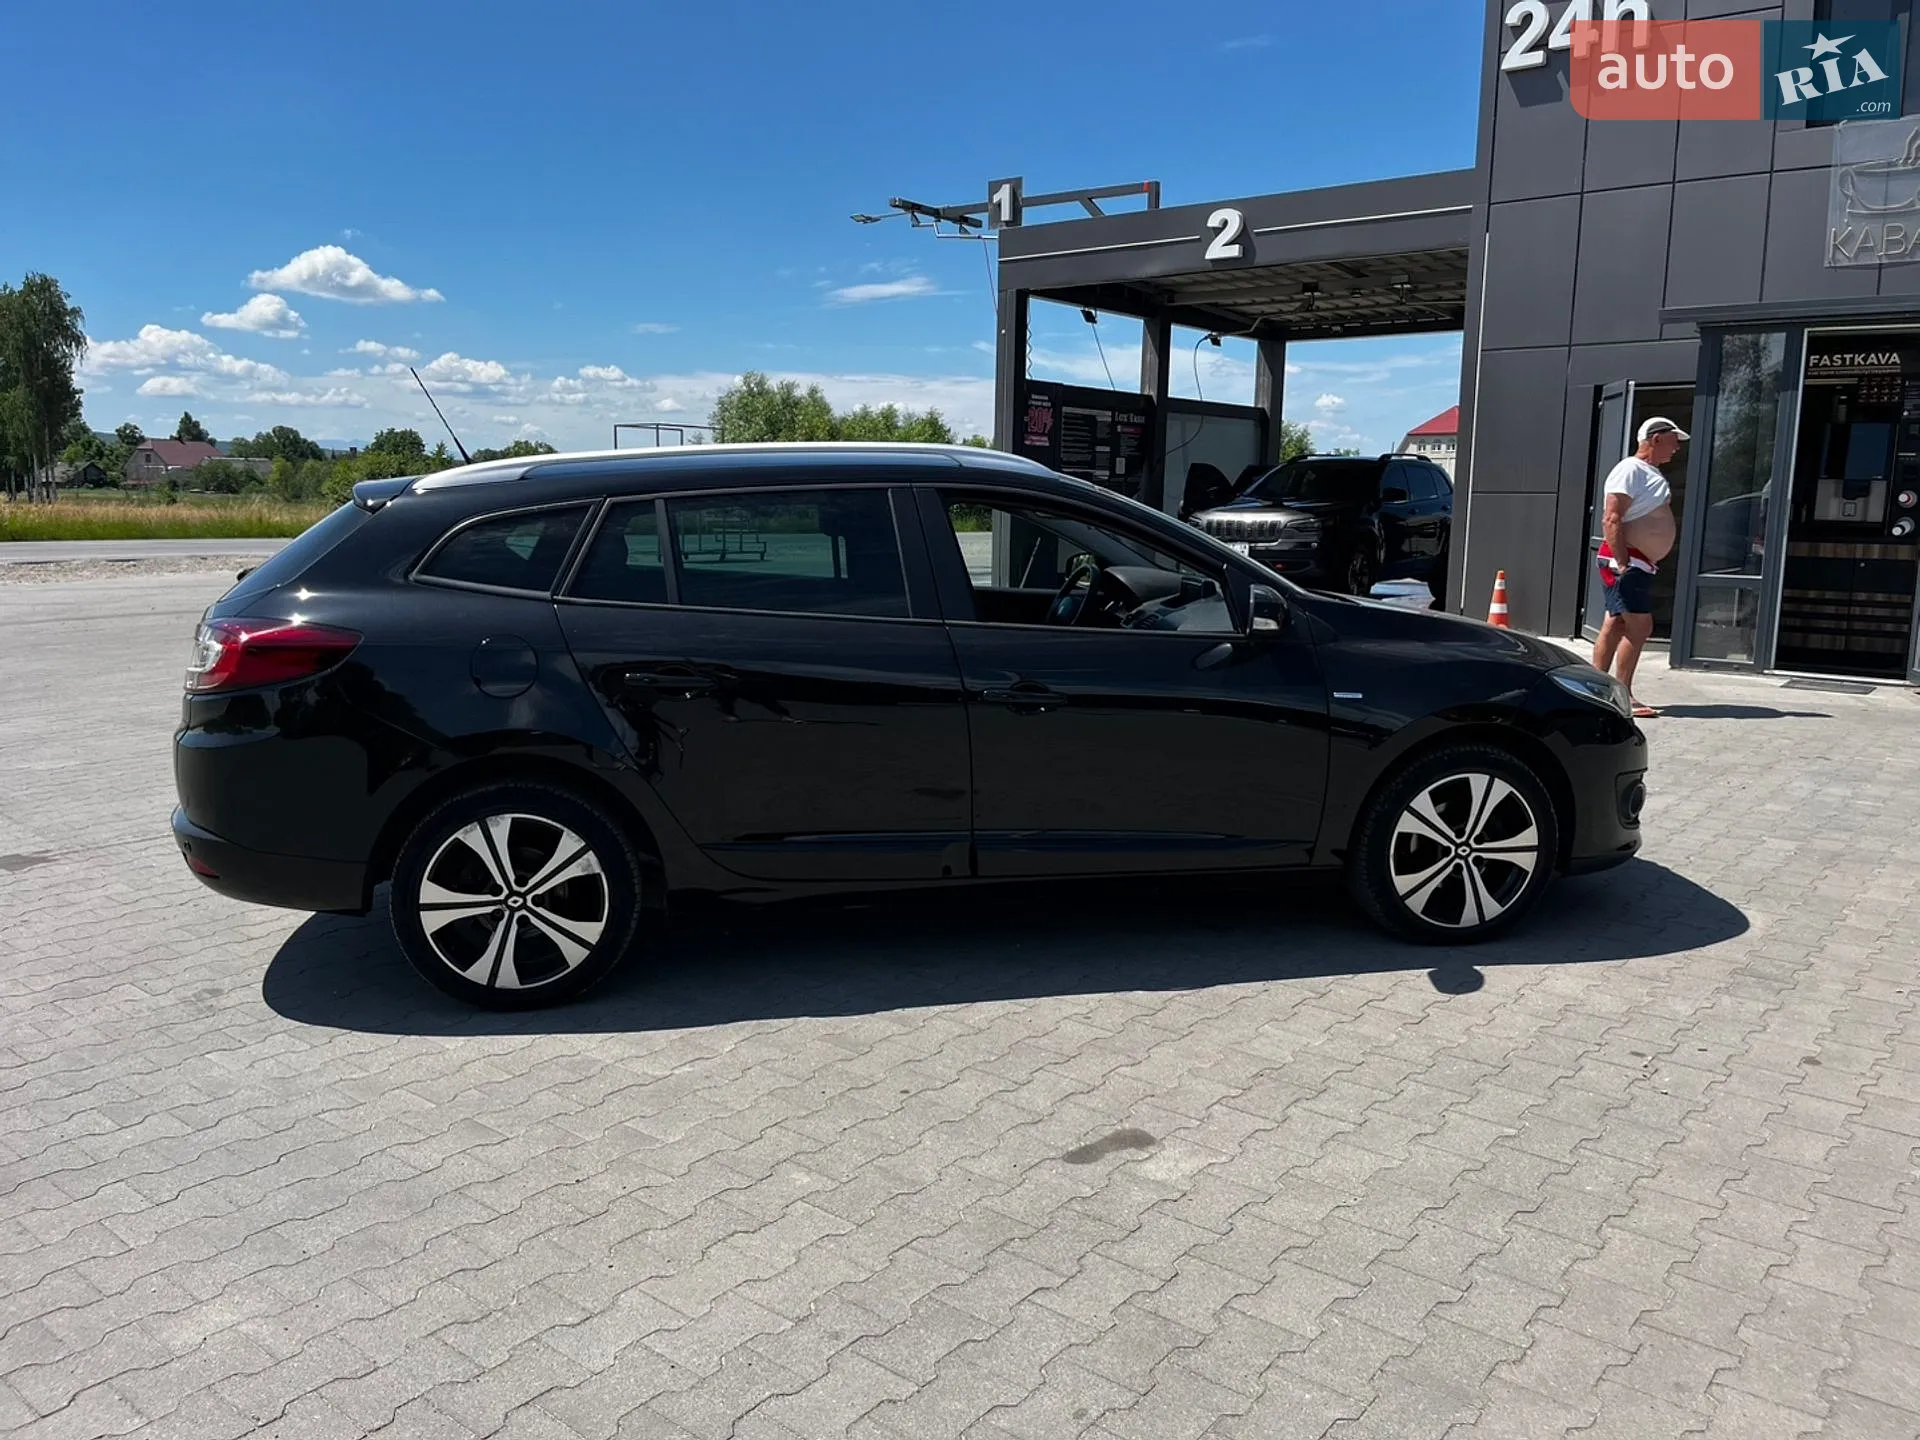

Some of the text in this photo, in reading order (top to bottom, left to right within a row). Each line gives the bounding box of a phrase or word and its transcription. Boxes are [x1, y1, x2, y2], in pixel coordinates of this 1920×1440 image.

[1501, 0, 1649, 70] 24h
[993, 183, 1013, 221] 1
[1205, 208, 1243, 259] 2
[1808, 352, 1901, 367] FASTKAVA
